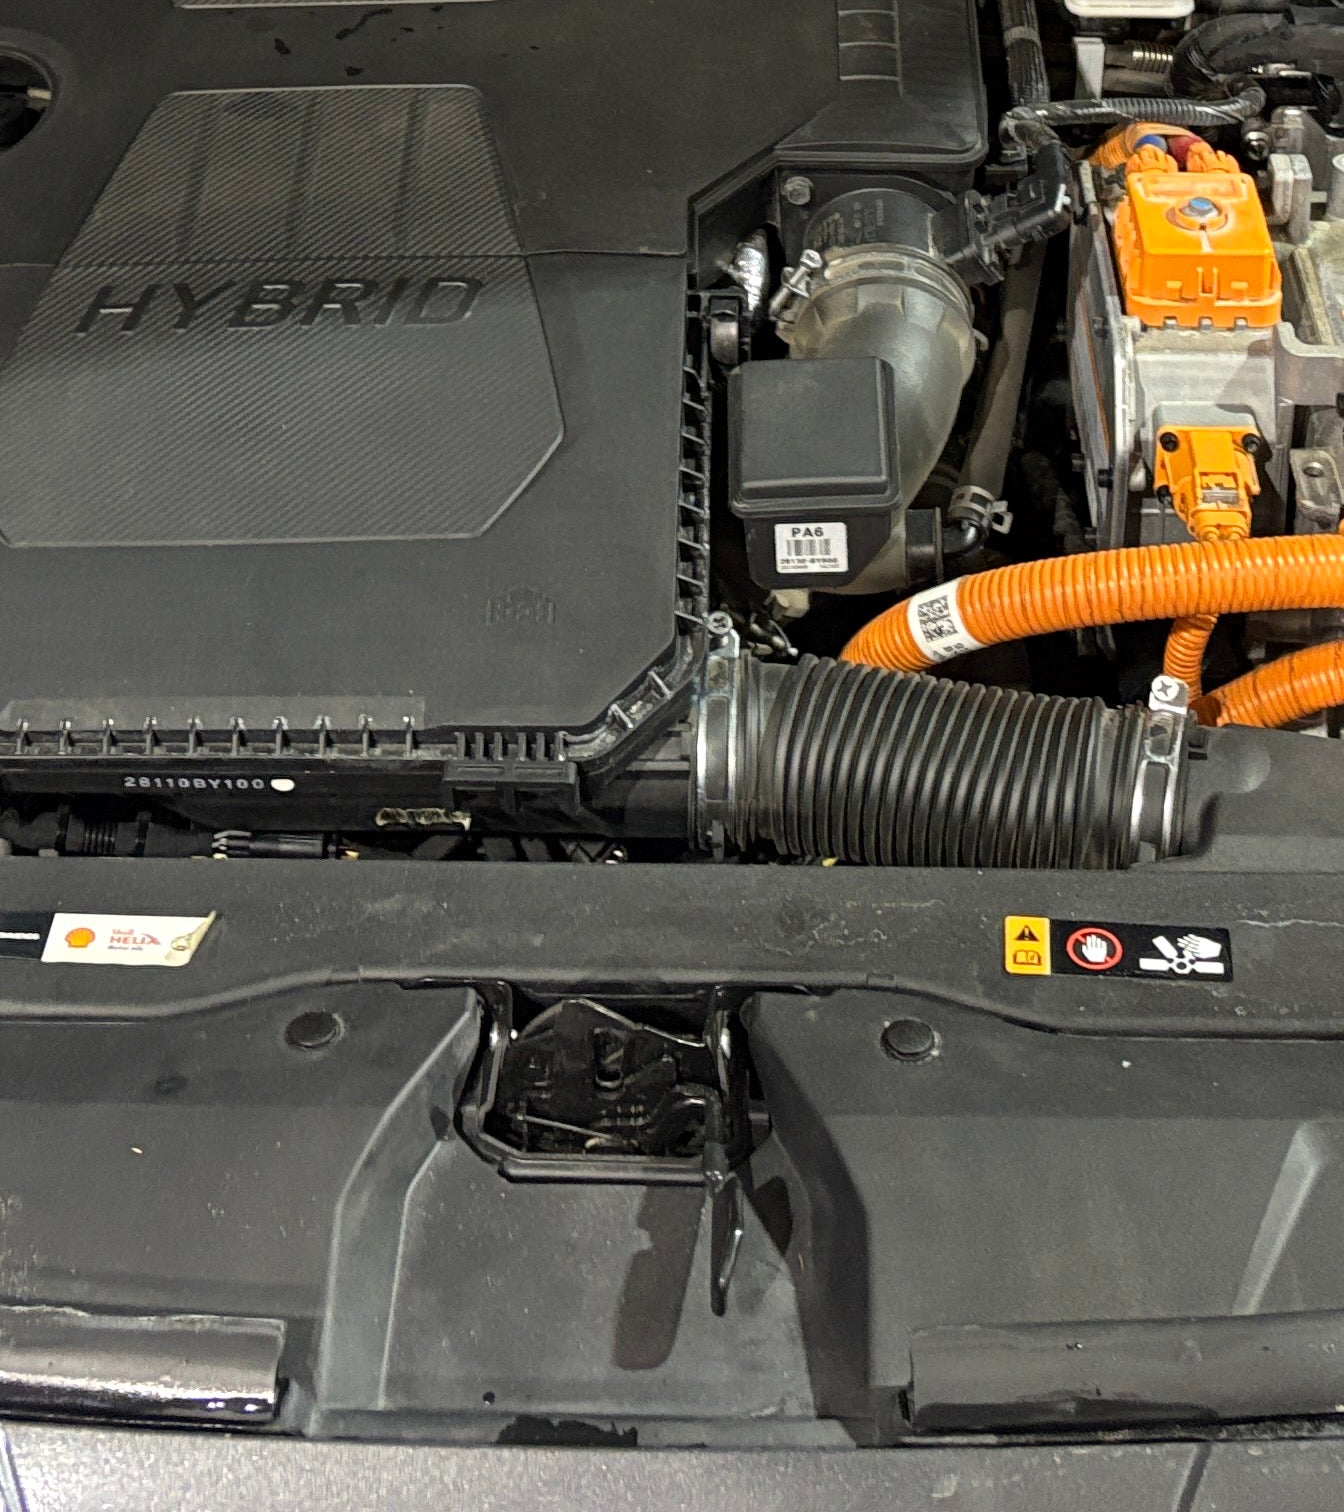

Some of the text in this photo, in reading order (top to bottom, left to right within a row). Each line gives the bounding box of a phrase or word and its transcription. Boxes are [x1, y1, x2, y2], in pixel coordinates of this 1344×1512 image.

[76, 276, 484, 337] HYBRID
[791, 526, 825, 538] PA6
[124, 776, 265, 789] 28110BY100
[110, 933, 162, 946] HELIX
